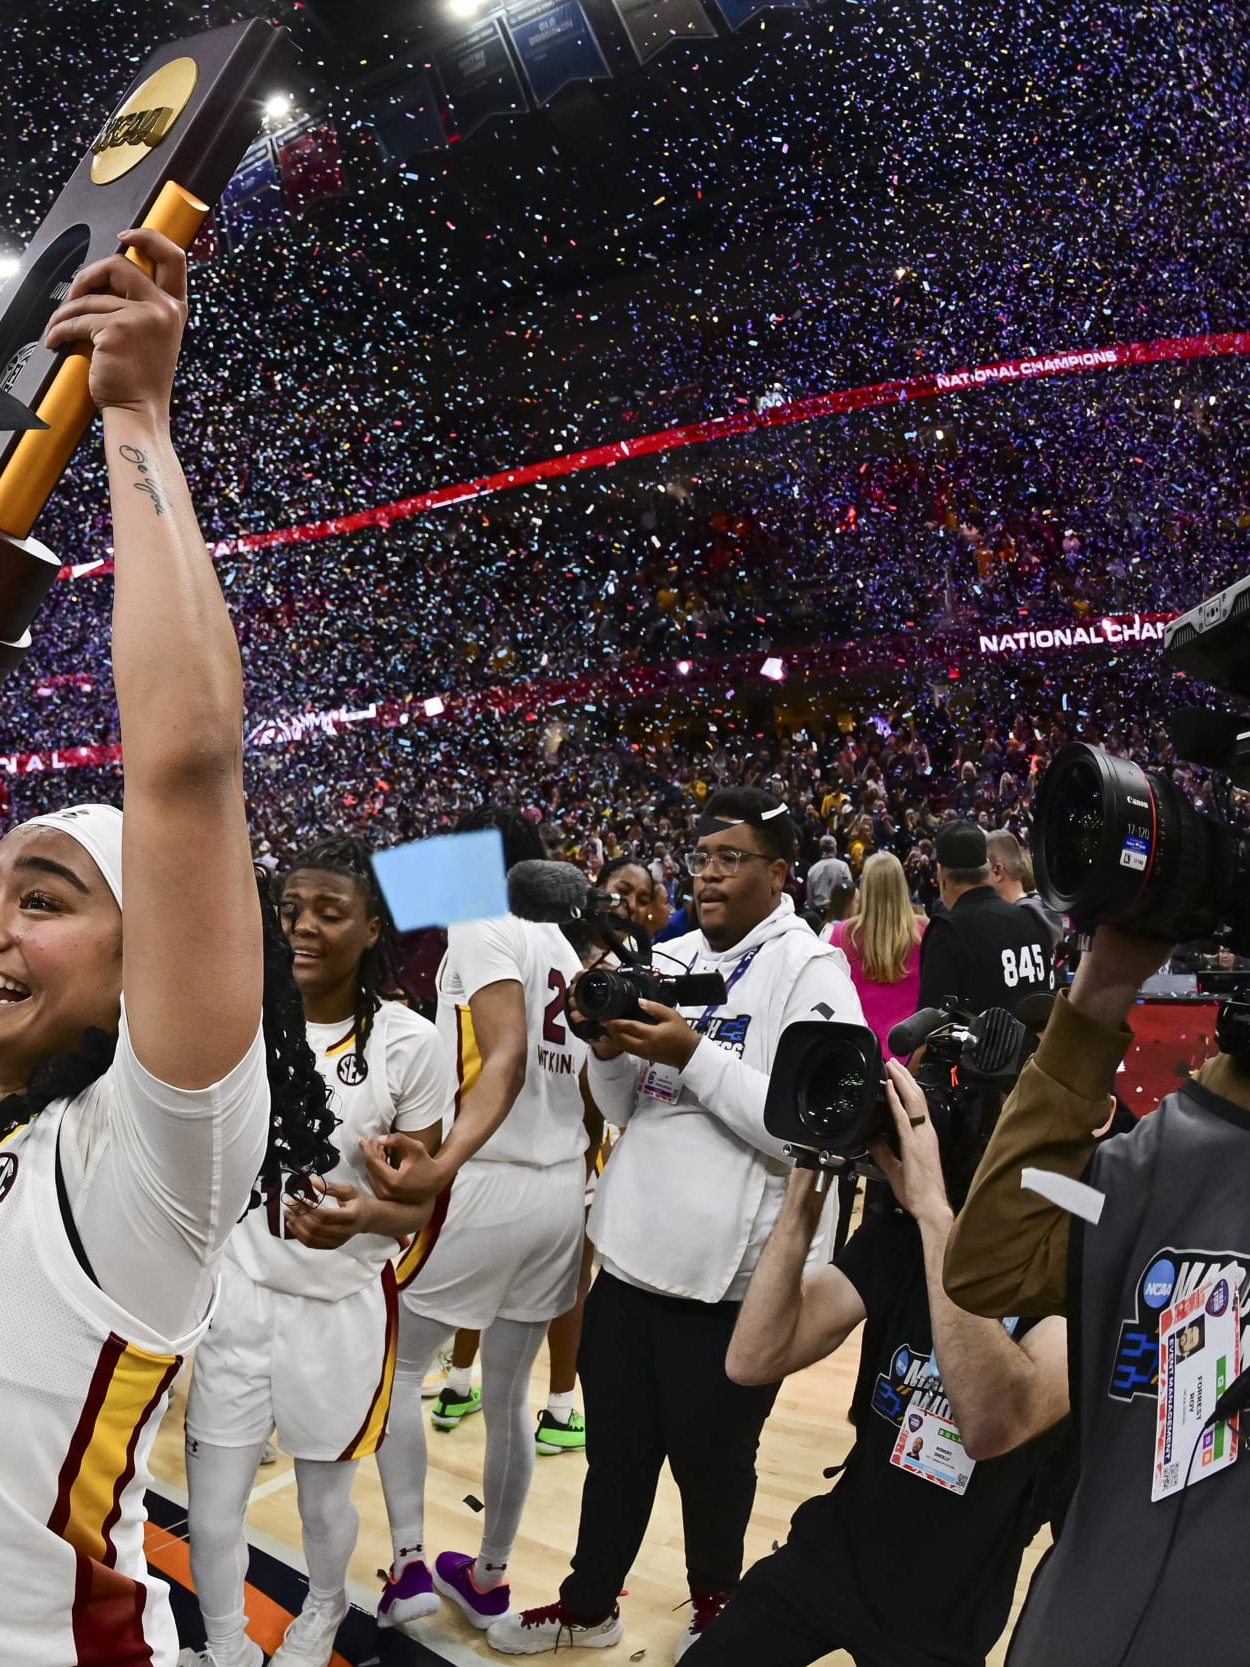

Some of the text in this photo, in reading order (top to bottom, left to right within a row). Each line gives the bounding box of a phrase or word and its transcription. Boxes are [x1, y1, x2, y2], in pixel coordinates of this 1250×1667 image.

[936, 349, 1118, 389] NATIONAL CHAMPIONS
[978, 626, 1104, 652] NATIONAL
[1126, 795, 1149, 809] Canon
[1001, 943, 1045, 988] 845
[1145, 1282, 1173, 1297] NCAA
[1163, 1338, 1176, 1460] EVENT MANAGEMENT
[1195, 1375, 1203, 1421] FORREST
